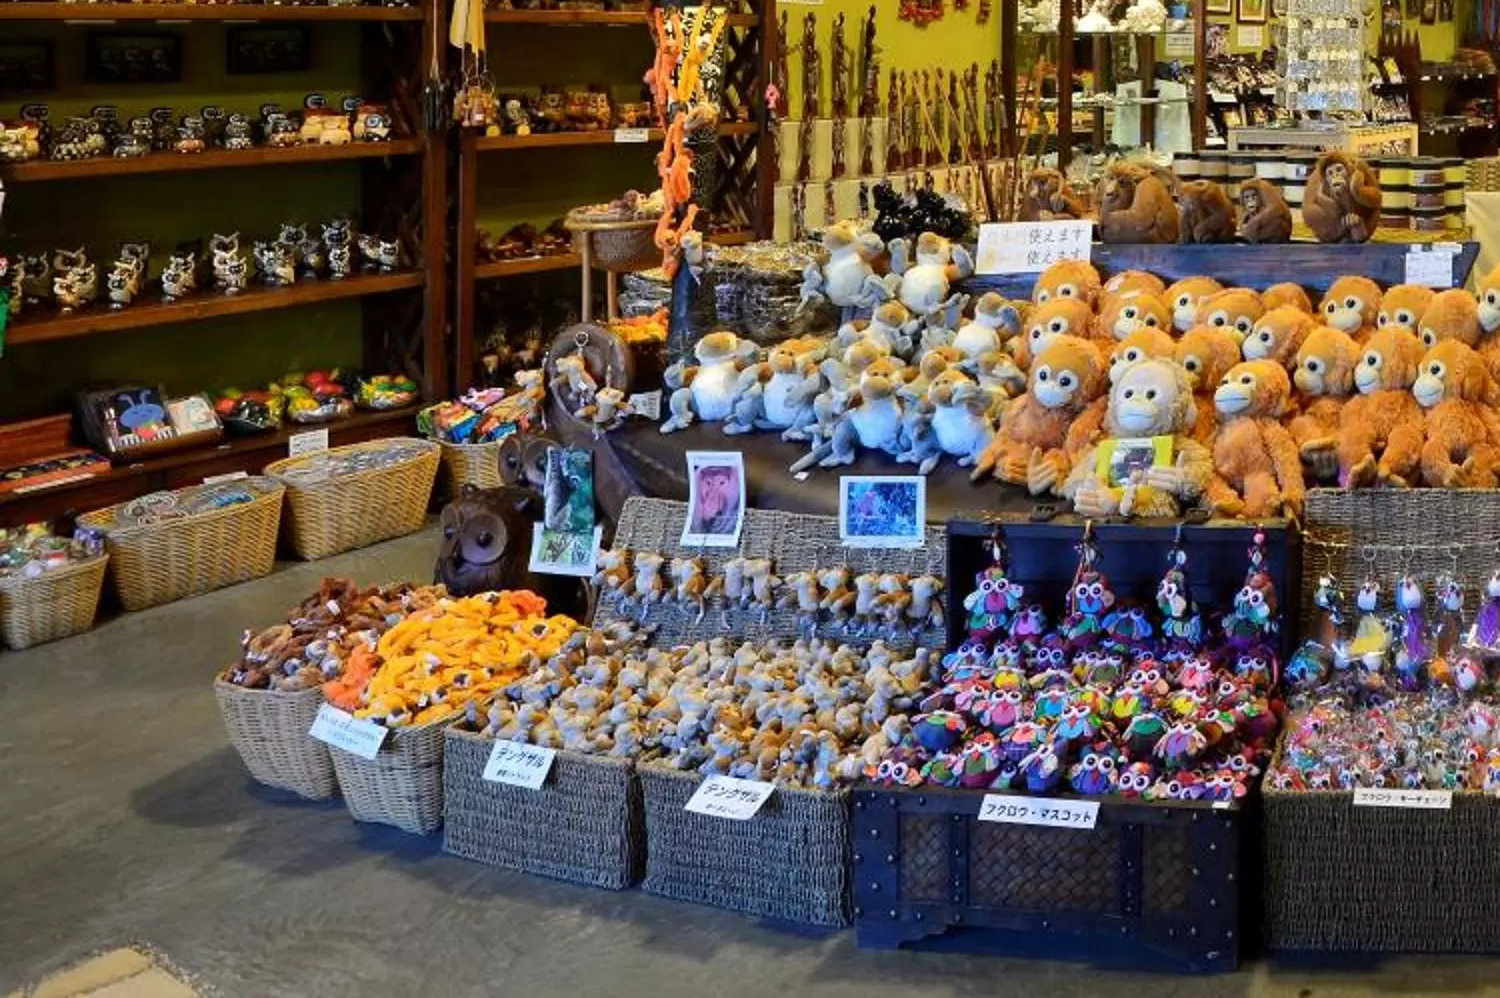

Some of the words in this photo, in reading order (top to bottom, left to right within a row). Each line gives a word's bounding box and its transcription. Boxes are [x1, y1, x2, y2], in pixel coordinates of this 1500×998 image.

[986, 803, 1092, 823] フクロウ・マスコット
